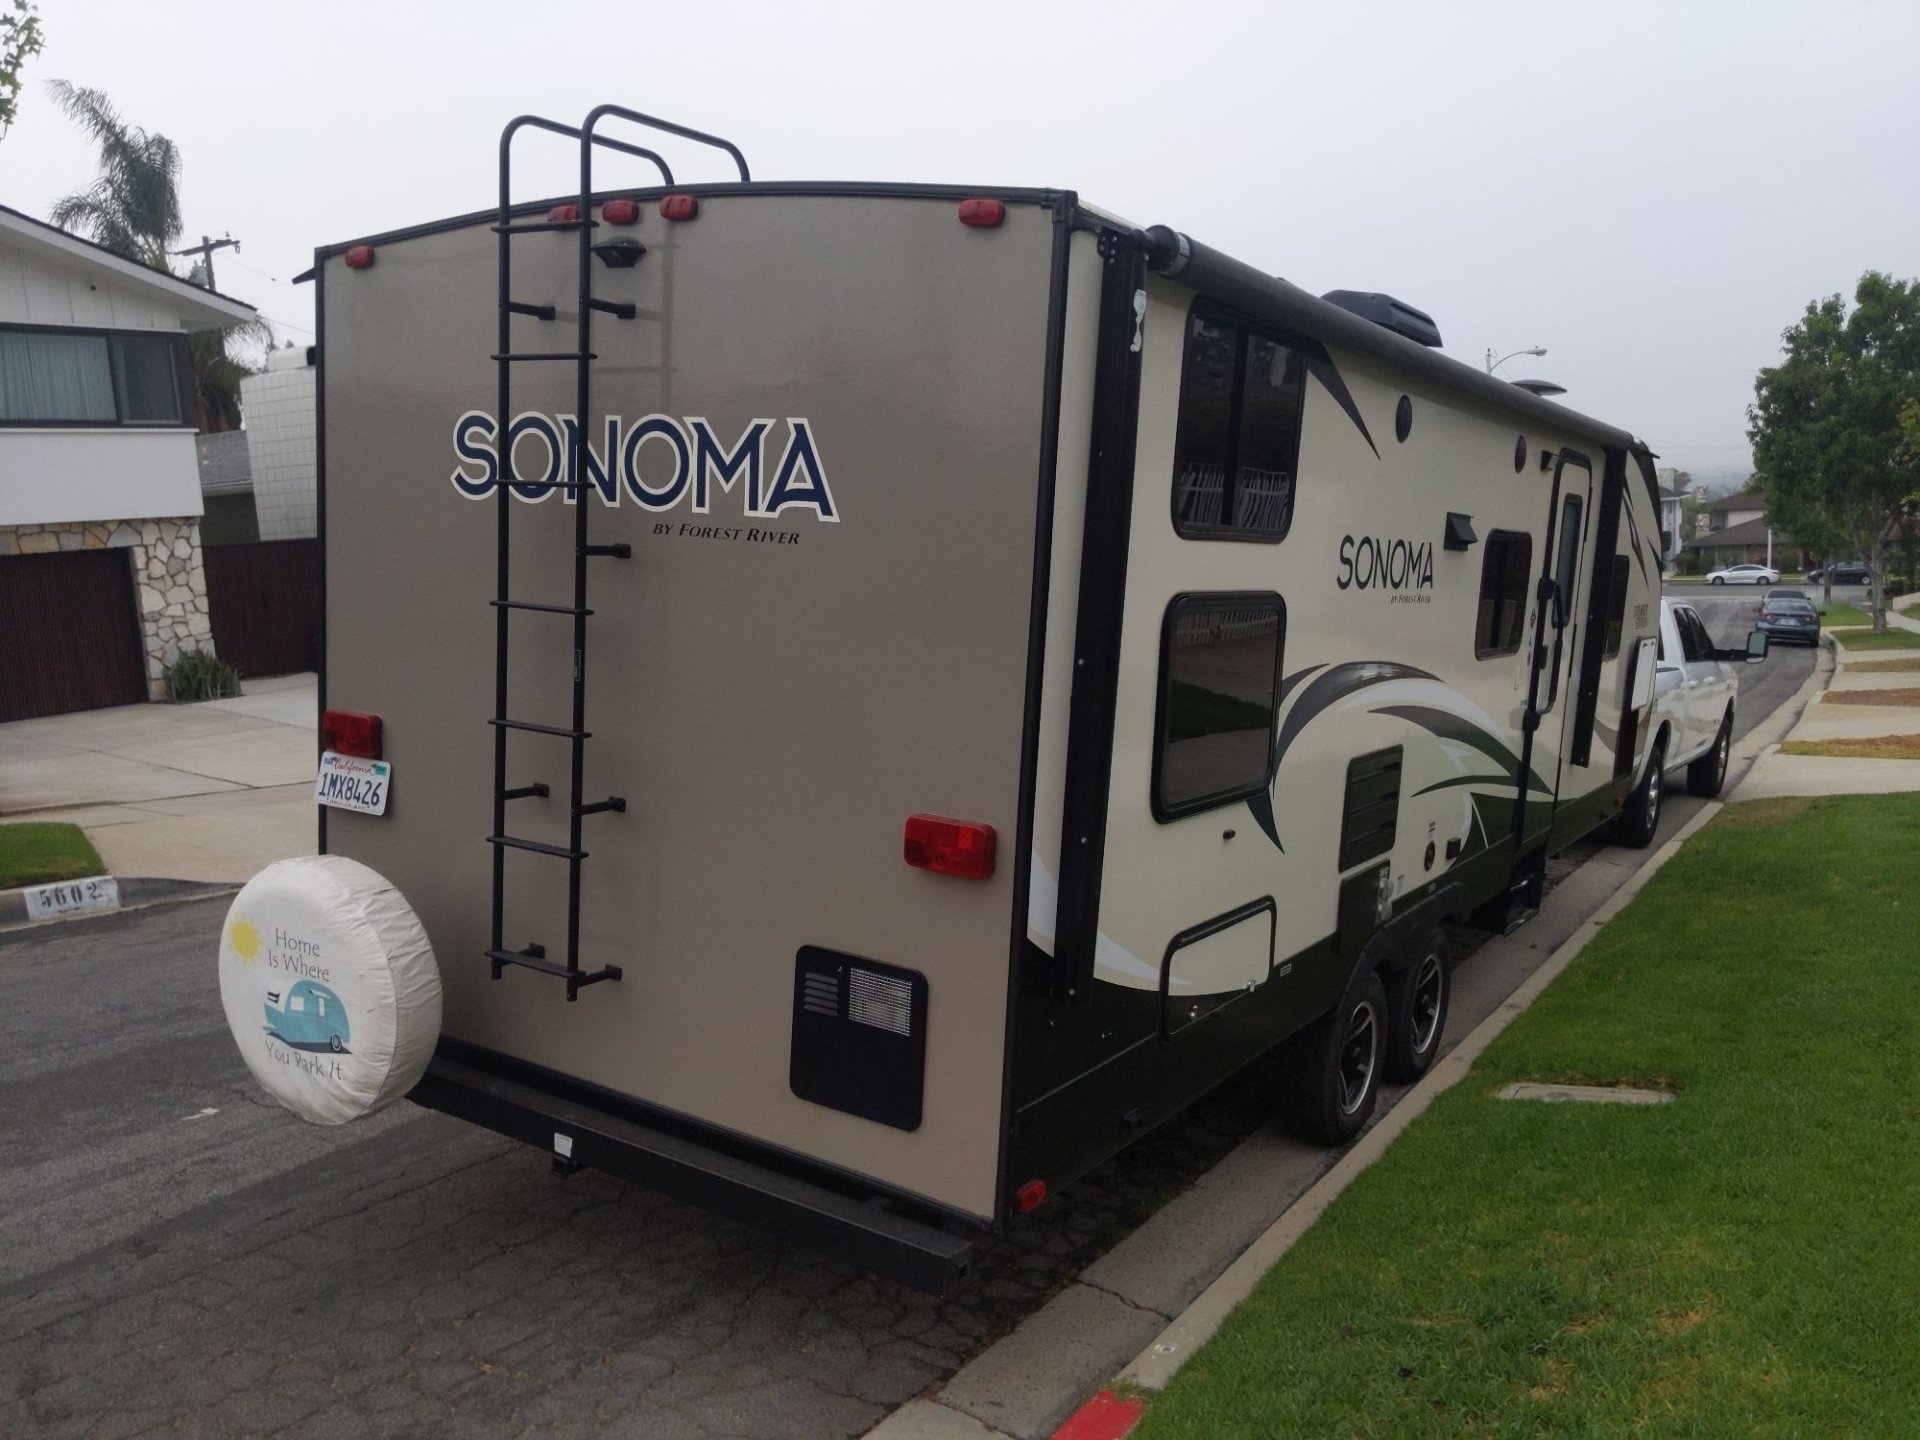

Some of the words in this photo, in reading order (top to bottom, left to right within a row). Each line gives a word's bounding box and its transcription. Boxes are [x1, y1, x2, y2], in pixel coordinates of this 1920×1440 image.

[450, 409, 841, 523] SONOMA
[653, 523, 675, 536] BY
[1336, 534, 1433, 590] SONOMA
[319, 772, 383, 807] 1MX8426
[40, 881, 103, 909] 5602
[275, 927, 321, 958] Home
[268, 949, 280, 969] Is
[282, 952, 331, 983] Where
[264, 1040, 290, 1067] You
[293, 1050, 325, 1077] Park
